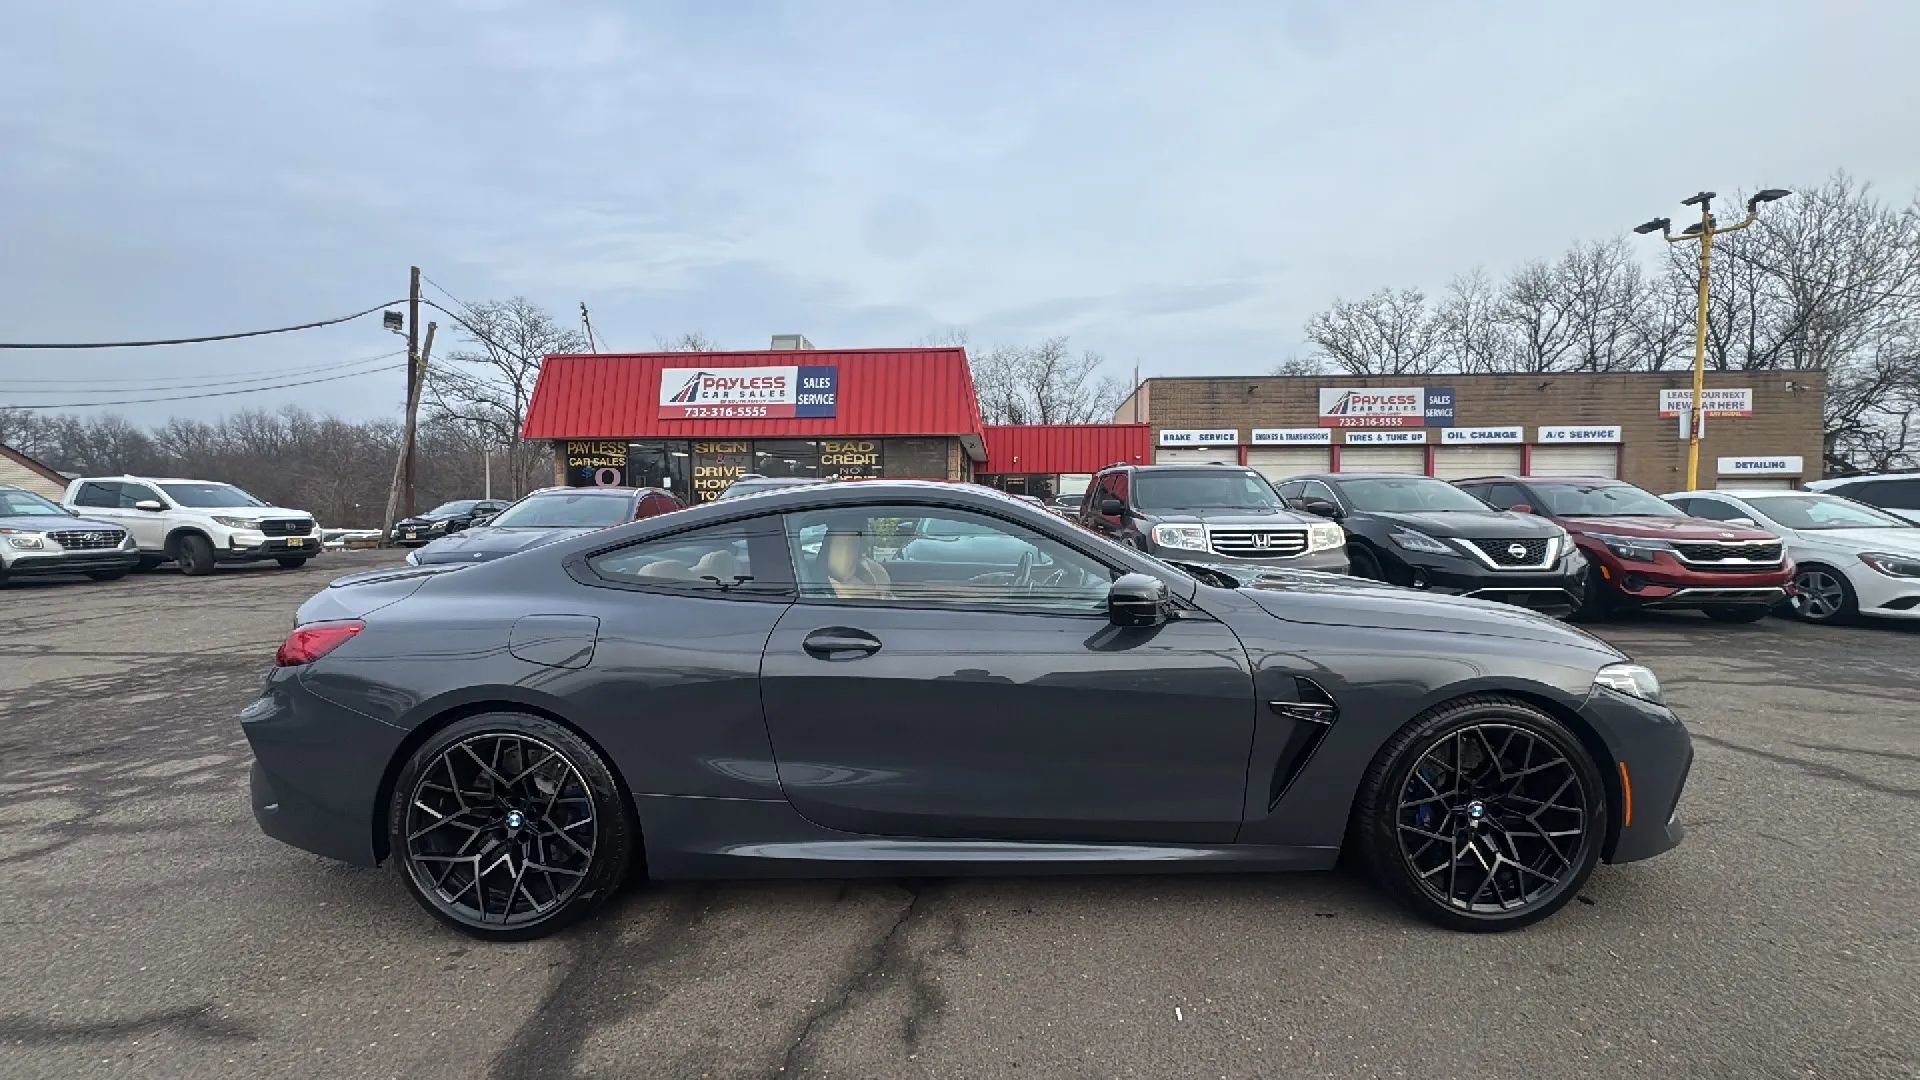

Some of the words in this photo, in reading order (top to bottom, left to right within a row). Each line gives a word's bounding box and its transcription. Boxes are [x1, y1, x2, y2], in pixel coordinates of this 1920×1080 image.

[703, 376, 786, 390] PAYLESS
[803, 377, 831, 389] SALES
[702, 391, 729, 399] CAR
[740, 390, 786, 398] SALES
[797, 393, 835, 405] SERVICE
[1667, 391, 1694, 399] LEASE
[1701, 391, 1720, 399] OUR
[1721, 391, 1746, 399] NEXT
[1351, 395, 1417, 405] PAYLESS
[1429, 395, 1450, 405] SALES
[1667, 401, 1693, 410] NEW
[1701, 401, 1716, 409] AR
[1717, 401, 1745, 410] HERE
[685, 407, 767, 417] 732-316-5555
[1425, 409, 1453, 417] SERVICE
[1339, 418, 1403, 427] 732-316-5555
[1163, 433, 1191, 441] BRAKE
[1199, 433, 1235, 441] SERVICE
[1348, 434, 1373, 442] TIRES
[1376, 434, 1383, 442] &
[1386, 433, 1409, 441] TUNE
[1411, 433, 1423, 441] UP
[1447, 431, 1465, 440] OIL
[1470, 430, 1518, 440] CHANGE
[1546, 430, 1565, 439] A/C
[1569, 430, 1615, 439] SERVICE
[567, 441, 627, 455] PAYLESS
[695, 442, 747, 453] SIGN
[825, 441, 875, 453] BAD
[569, 457, 590, 467] CAR
[593, 457, 626, 467] SALES
[715, 454, 726, 464] &
[821, 453, 879, 465] CREDIT
[1735, 461, 1786, 469] DETAILING
[694, 466, 746, 477] DRIVE
[839, 467, 861, 475] NO
[694, 479, 735, 489] HOM
